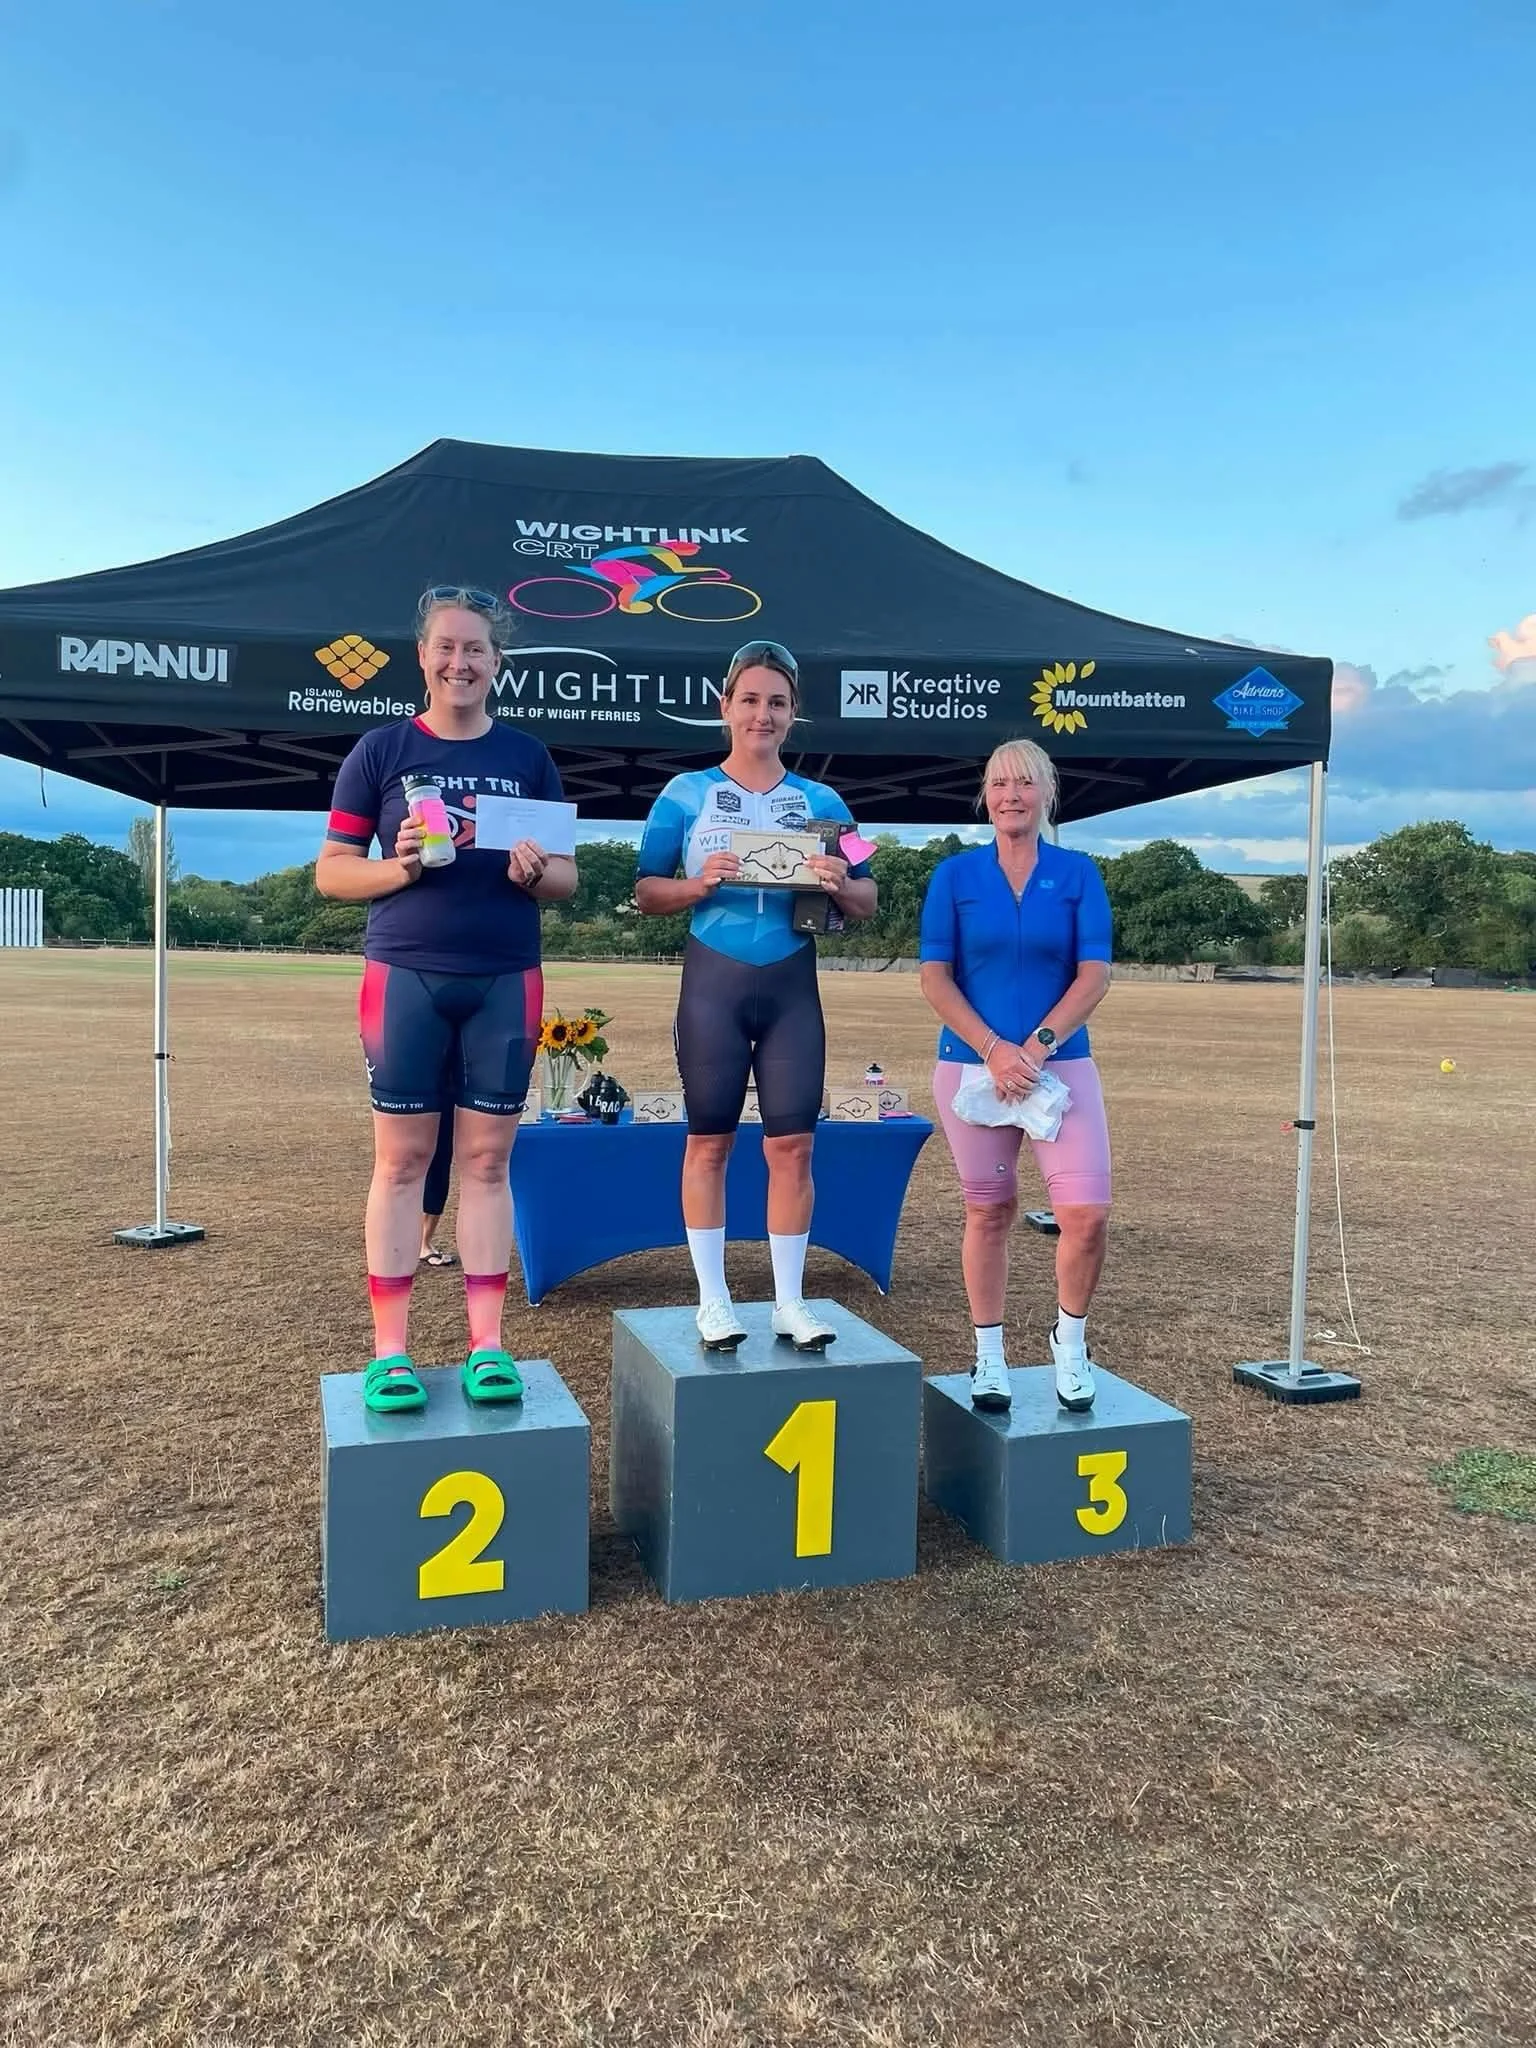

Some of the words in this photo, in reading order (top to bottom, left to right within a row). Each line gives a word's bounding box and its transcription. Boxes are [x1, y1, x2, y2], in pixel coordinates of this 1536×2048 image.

[515, 519, 750, 544] WIGHTLINK
[512, 538, 600, 560] CRT
[60, 636, 229, 683] RAPANUI
[304, 687, 343, 698] ISLAND
[491, 669, 728, 705] WIGHTLIN
[891, 671, 1001, 694] Kreative
[1232, 681, 1286, 699] Adrians
[288, 690, 417, 717] Renewables
[891, 696, 988, 719] Studios
[1055, 689, 1186, 708] Mountbatten
[497, 706, 525, 718] ISLE
[528, 707, 545, 719] OF
[547, 708, 587, 721] WIGHT
[590, 709, 641, 723] FERRIES
[1262, 705, 1285, 717] SHOP
[400, 774, 479, 791] WGHT
[485, 776, 520, 797] TRI
[380, 1101, 407, 1109] WIGHT
[474, 1099, 502, 1110] WIGHT
[764, 1400, 836, 1558] 1
[1075, 1450, 1129, 1536] 3
[418, 1470, 507, 1601] 2
